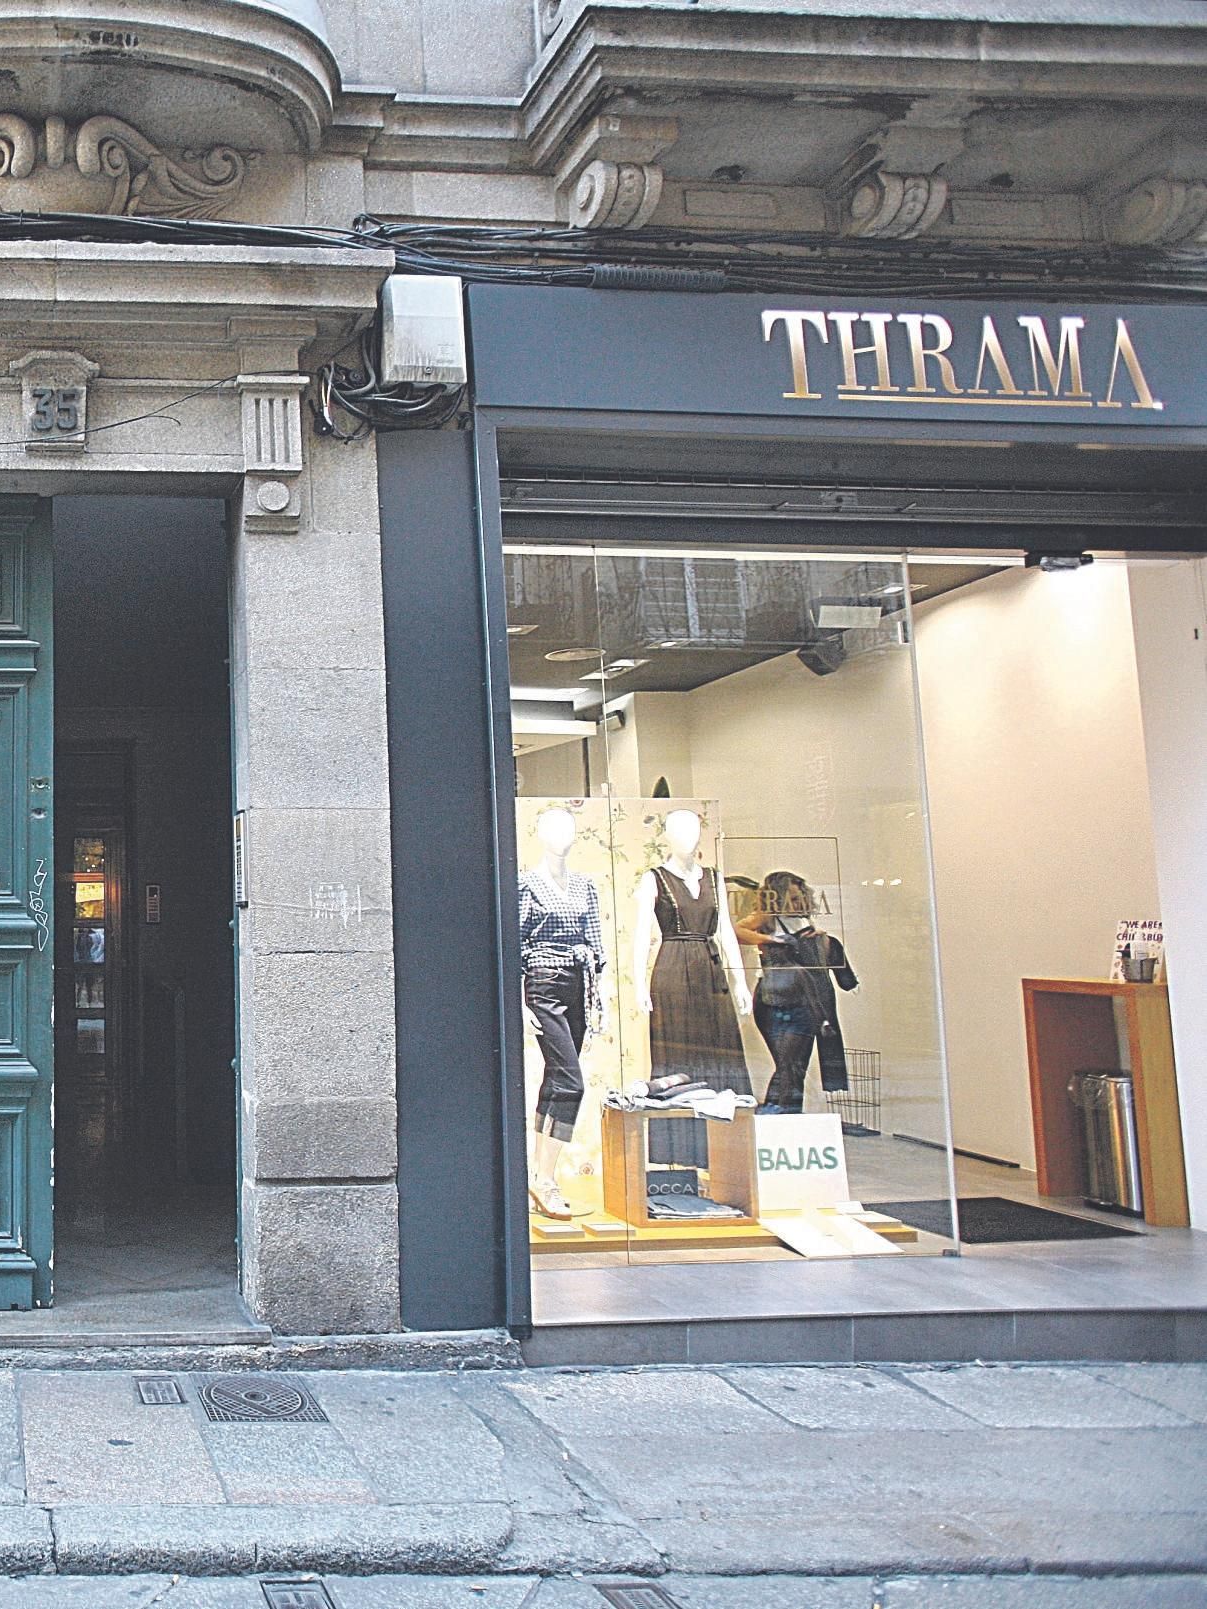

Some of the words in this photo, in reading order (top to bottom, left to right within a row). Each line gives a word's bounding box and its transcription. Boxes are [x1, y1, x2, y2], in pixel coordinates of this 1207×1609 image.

[761, 310, 1163, 410] THRAMA
[32, 388, 78, 430] 35
[758, 1147, 839, 1171] BAJAS
